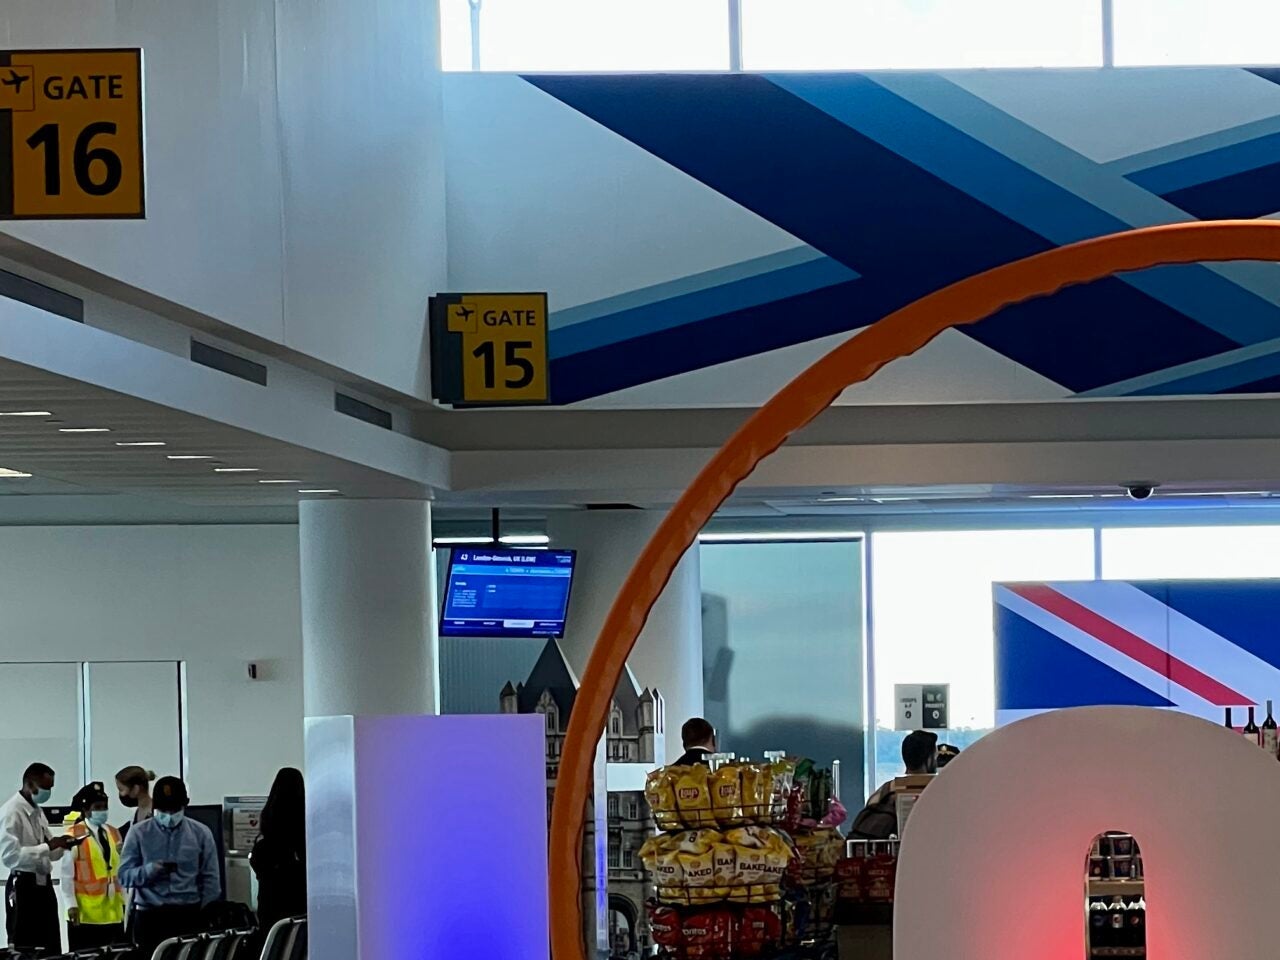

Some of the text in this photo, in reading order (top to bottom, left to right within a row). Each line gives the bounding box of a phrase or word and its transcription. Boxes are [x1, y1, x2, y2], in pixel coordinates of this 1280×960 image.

[43, 75, 123, 100] GATE
[26, 122, 122, 195] 16
[483, 310, 536, 326] GATE
[473, 341, 534, 389] 15
[688, 868, 712, 877] AKED
